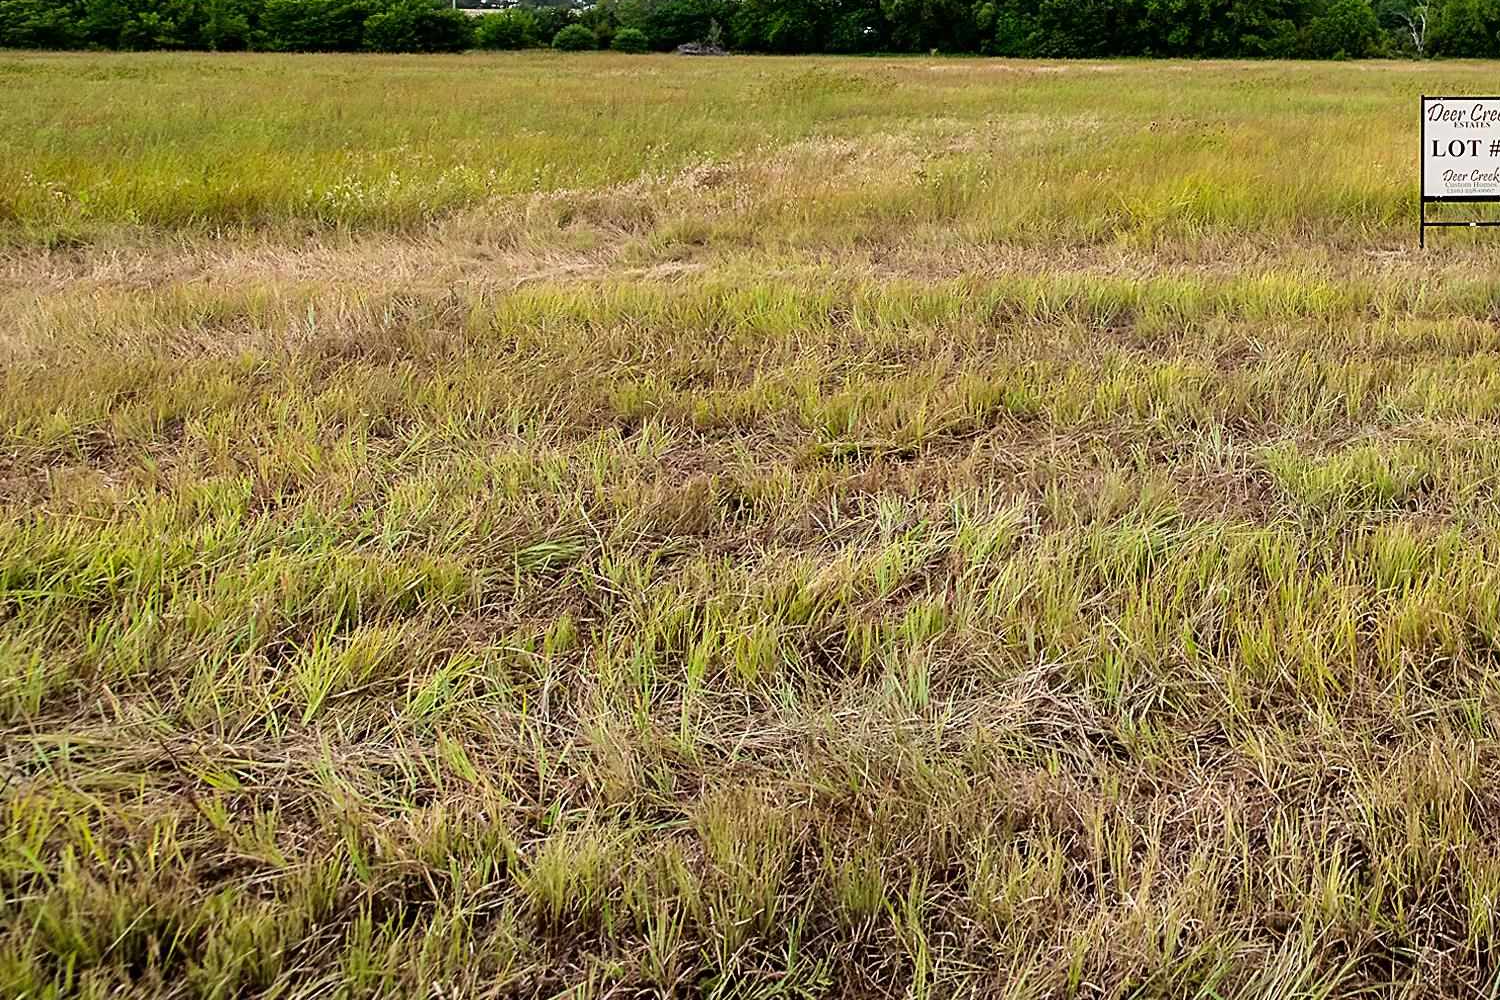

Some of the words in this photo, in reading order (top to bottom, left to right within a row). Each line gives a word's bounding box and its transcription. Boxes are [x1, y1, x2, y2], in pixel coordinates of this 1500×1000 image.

[1428, 103, 1466, 122] Deer
[1432, 139, 1482, 157] LOT
[1442, 168, 1468, 182] Deer
[1471, 166, 1500, 183] Creek
